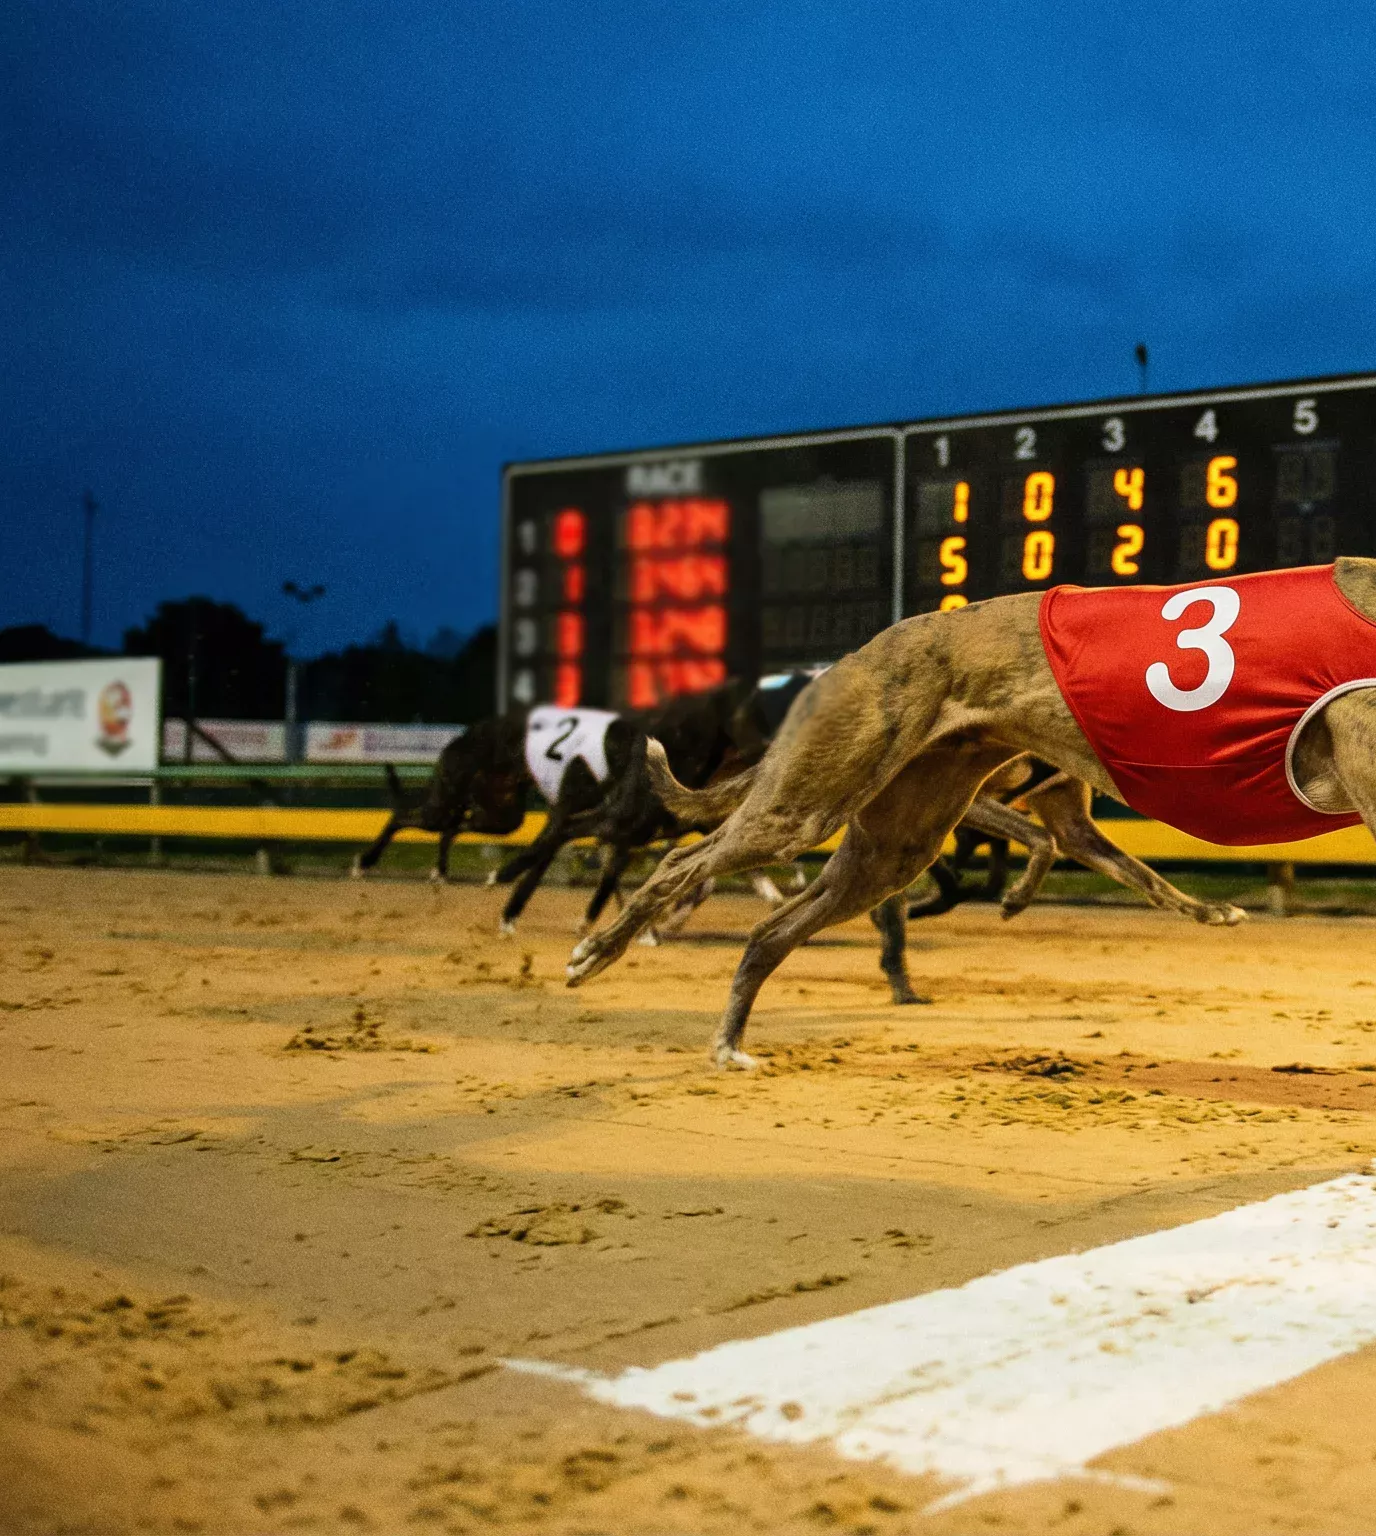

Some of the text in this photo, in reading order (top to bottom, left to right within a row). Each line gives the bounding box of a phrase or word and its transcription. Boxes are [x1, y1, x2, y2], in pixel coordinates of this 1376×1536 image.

[934, 436, 950, 467] 1
[1014, 427, 1037, 460] 2
[1104, 418, 1126, 452] 3
[1194, 409, 1218, 442] 4
[1293, 400, 1319, 434] 5
[953, 455, 1239, 523] 1 0 4 6
[939, 517, 1240, 586] 5 0 2 0
[1145, 586, 1240, 712] 3
[545, 716, 580, 761] 2
